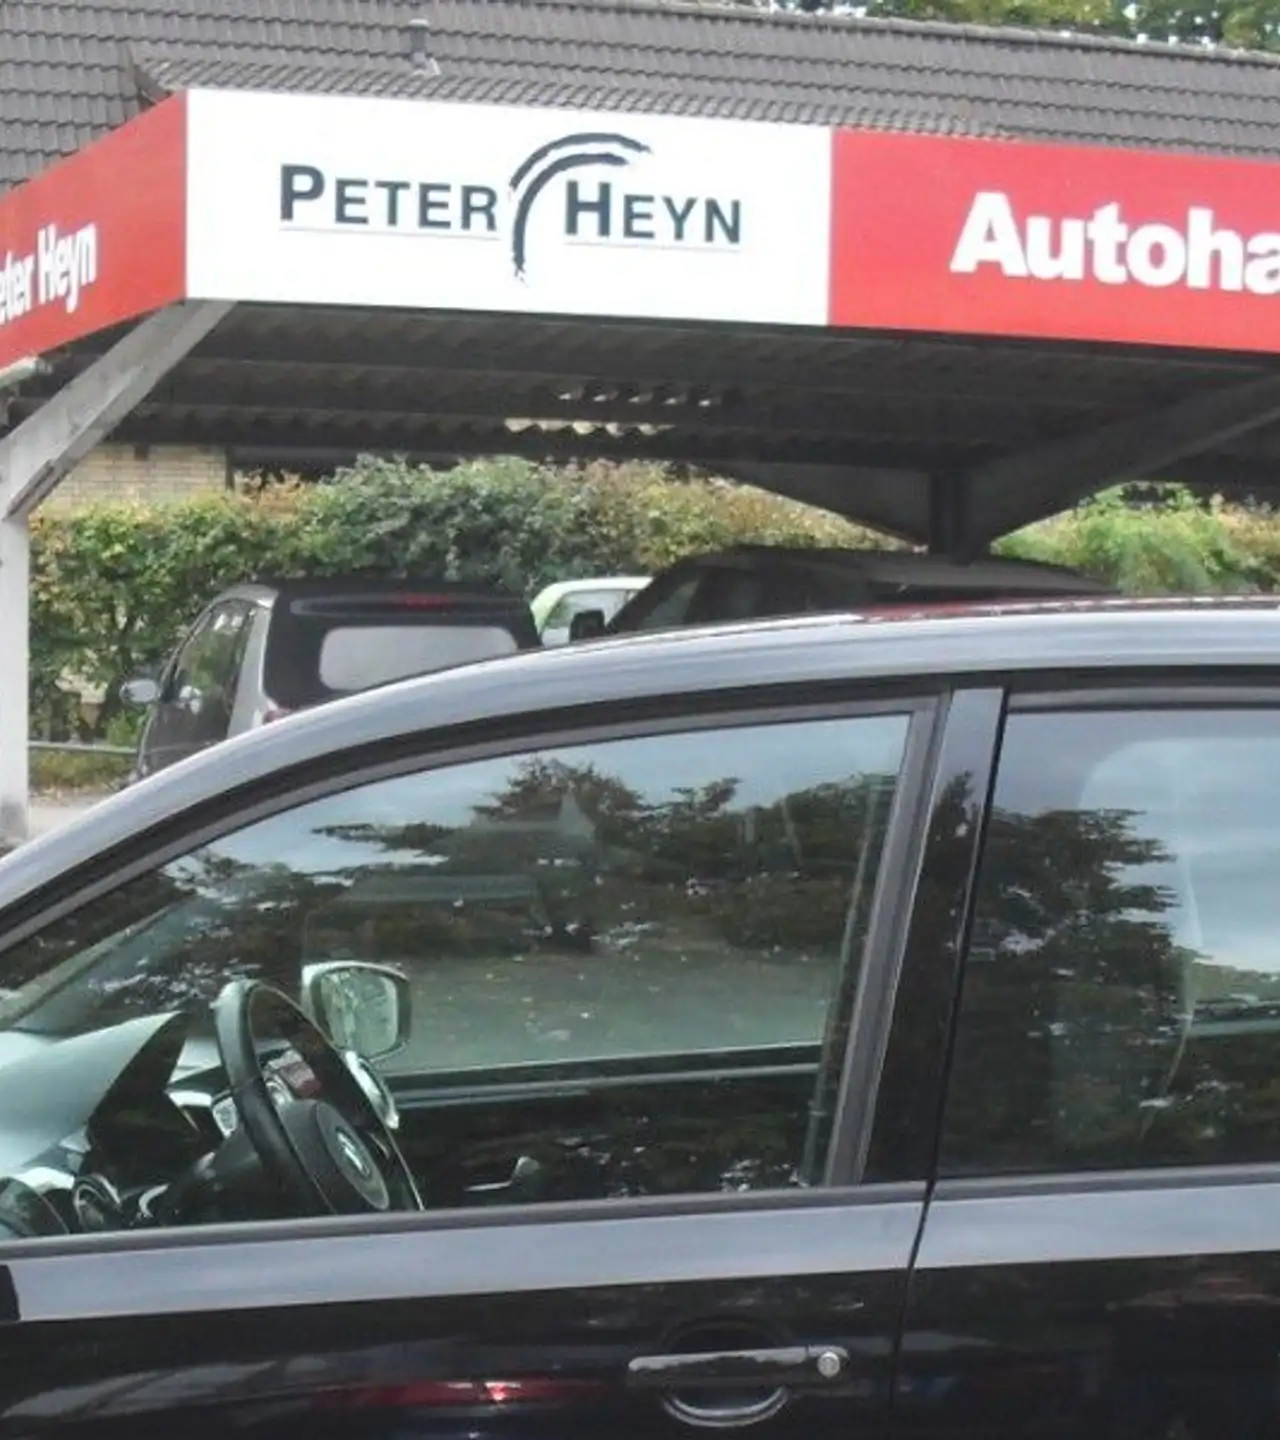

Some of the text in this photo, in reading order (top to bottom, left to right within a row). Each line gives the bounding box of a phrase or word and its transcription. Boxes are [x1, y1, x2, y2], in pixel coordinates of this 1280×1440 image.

[279, 163, 741, 244] PETER HEYN
[37, 222, 98, 313] Heyn
